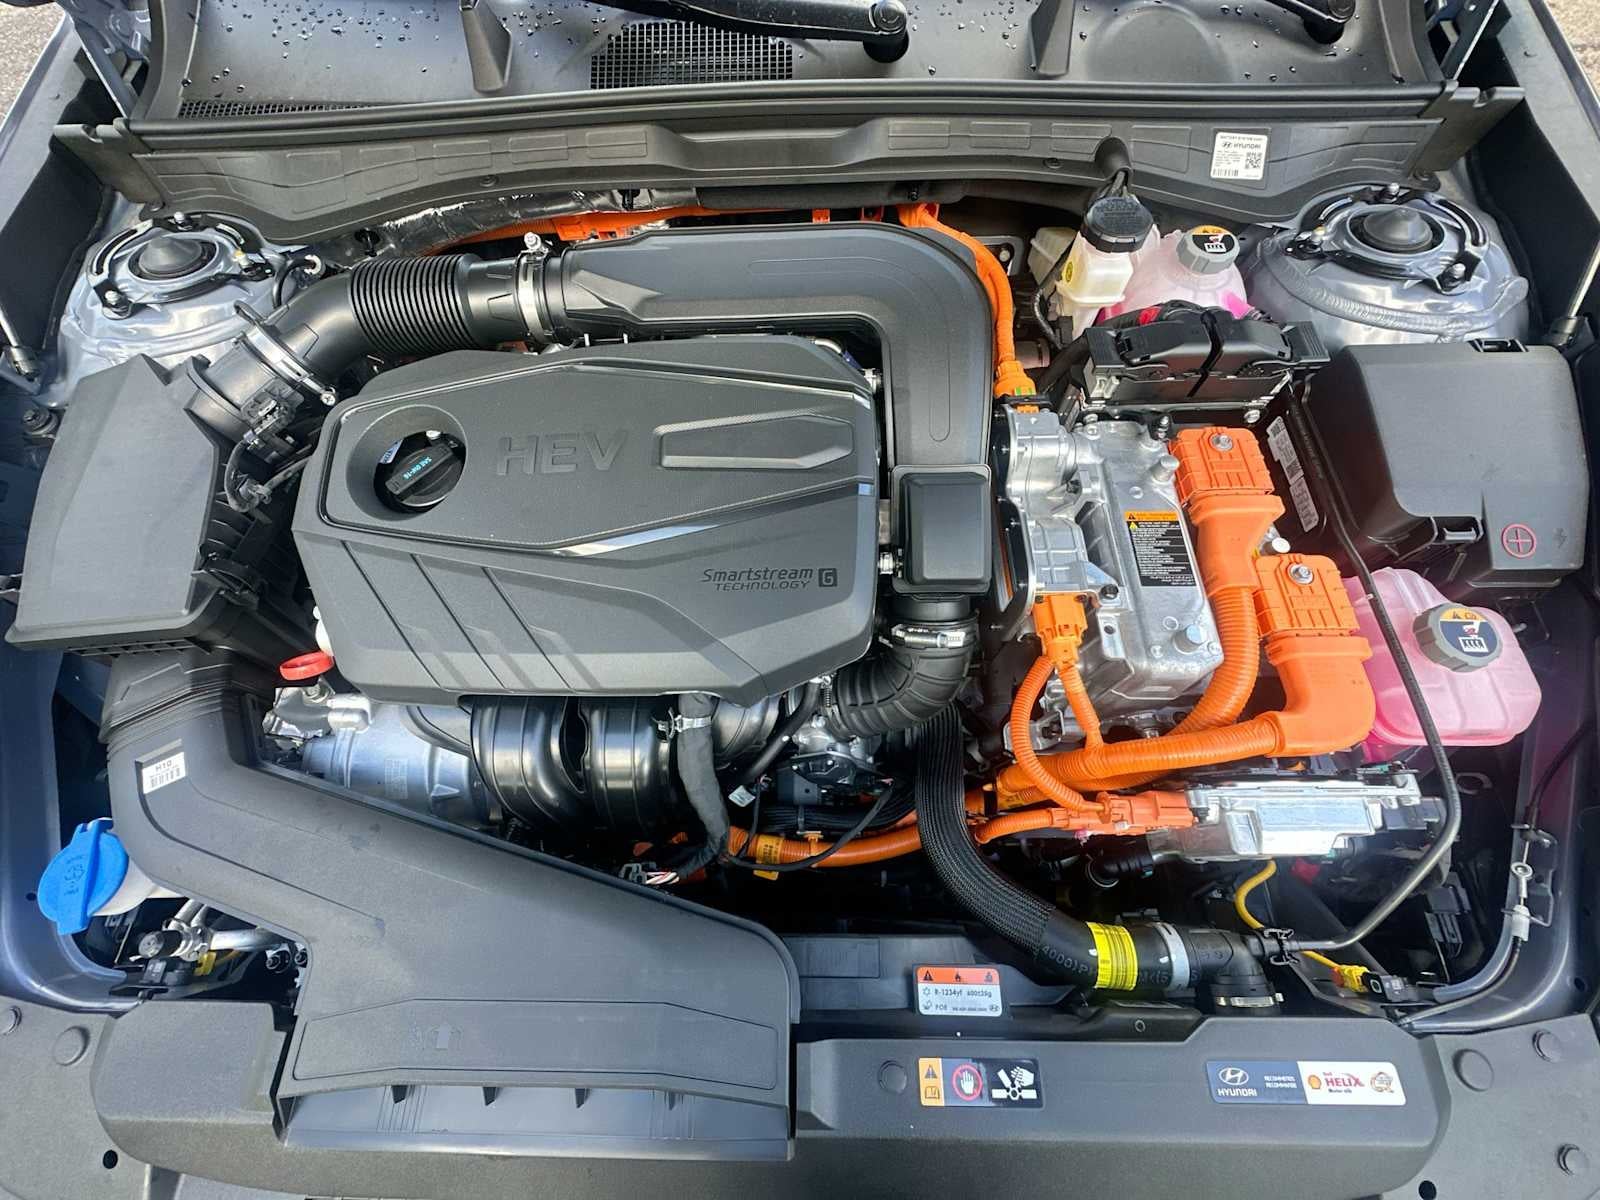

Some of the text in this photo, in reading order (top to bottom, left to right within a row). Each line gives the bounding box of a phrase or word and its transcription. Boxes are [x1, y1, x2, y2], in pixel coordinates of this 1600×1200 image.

[496, 432, 626, 475] HEV
[701, 567, 813, 582] Smartstream
[820, 568, 837, 587] G
[715, 580, 810, 591] TECHNOLOGY
[934, 988, 962, 998] R-1234yf
[1324, 1076, 1365, 1088] HELIX
[1217, 1087, 1258, 1097] HYUNDAI
